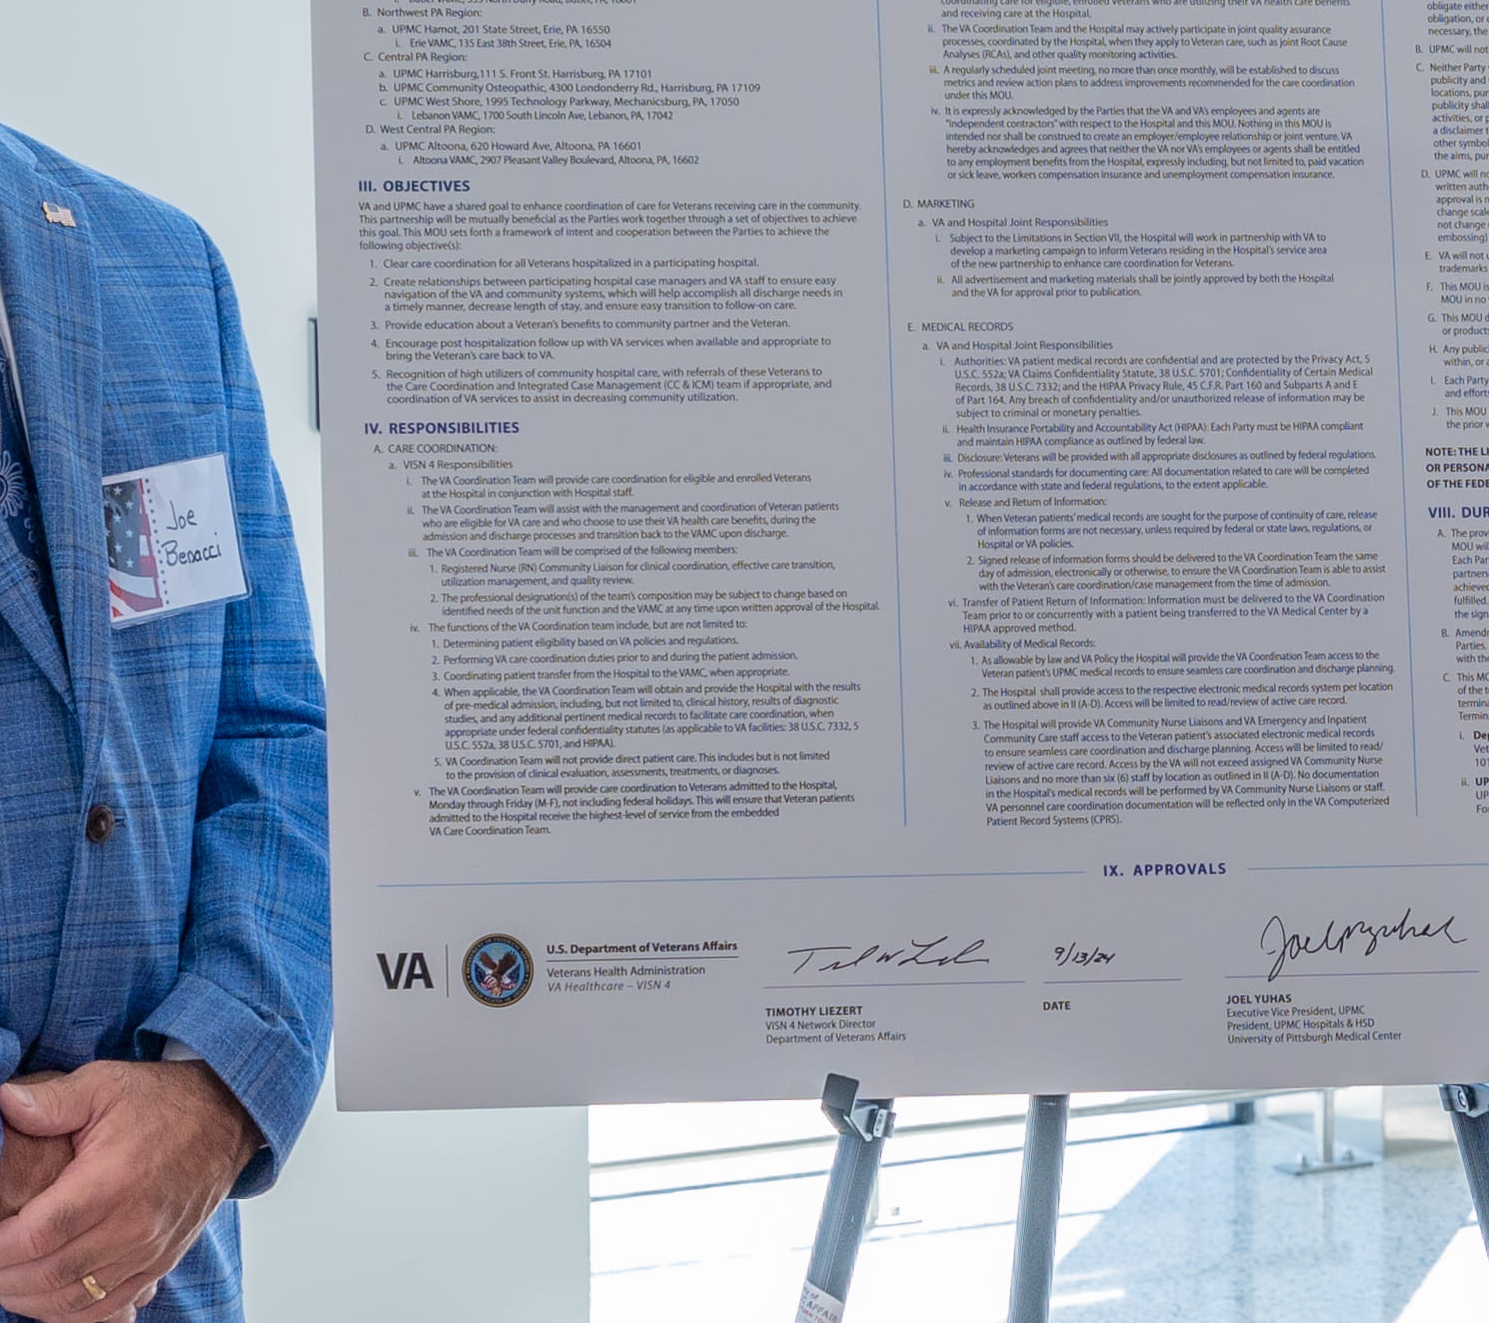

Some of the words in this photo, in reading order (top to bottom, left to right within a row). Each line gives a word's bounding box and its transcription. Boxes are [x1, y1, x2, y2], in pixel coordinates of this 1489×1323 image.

[358, 180, 377, 192] III.
[382, 180, 470, 192] OBJECTIVES
[364, 422, 382, 434] IV.
[388, 421, 519, 434] RESPONSIBILITIES
[387, 443, 414, 453] CARE
[416, 443, 498, 453] COORDINATION:
[166, 500, 198, 530] Joe
[1427, 506, 1455, 518] VIII.
[1103, 864, 1124, 876] IX.
[1133, 862, 1226, 876] APPROVALS
[546, 944, 568, 954] U.S.
[570, 943, 637, 956] Department
[638, 941, 650, 952] of
[651, 942, 700, 952] Veterans
[701, 940, 738, 951] Affairs
[1054, 941, 1116, 966] 9/13/24
[375, 952, 434, 990] VA
[546, 967, 591, 978] Veterans
[593, 965, 628, 977] Health
[629, 964, 706, 976] Administration
[564, 980, 624, 992] Healthcare
[636, 979, 661, 990] VISN
[1042, 1000, 1071, 1011] DATE
[1226, 994, 1252, 1004] JOEL
[1254, 993, 1292, 1004] YUHAS
[764, 1006, 816, 1017] TIMOTHY
[818, 1005, 863, 1016] LIEZERT
[1226, 1007, 1269, 1018] Executive
[1270, 1007, 1290, 1017] Vice
[1291, 1005, 1336, 1016] President,
[1338, 1004, 1365, 1015] UPMC
[765, 1020, 787, 1030] VISN
[797, 1019, 837, 1030] Network
[838, 1018, 875, 1029] Director
[1226, 1020, 1272, 1031] President,
[1273, 1019, 1301, 1030] UPMC
[1302, 1018, 1345, 1030] Hospitals
[1355, 1017, 1375, 1028] HSD
[765, 1034, 822, 1045] Department
[835, 1032, 875, 1042] Veterans
[877, 1030, 907, 1041] Affairs
[1227, 1033, 1273, 1045] University
[1285, 1031, 1333, 1044] Pittsburgh
[1334, 1030, 1370, 1041] Medical
[1371, 1030, 1401, 1040] Center
